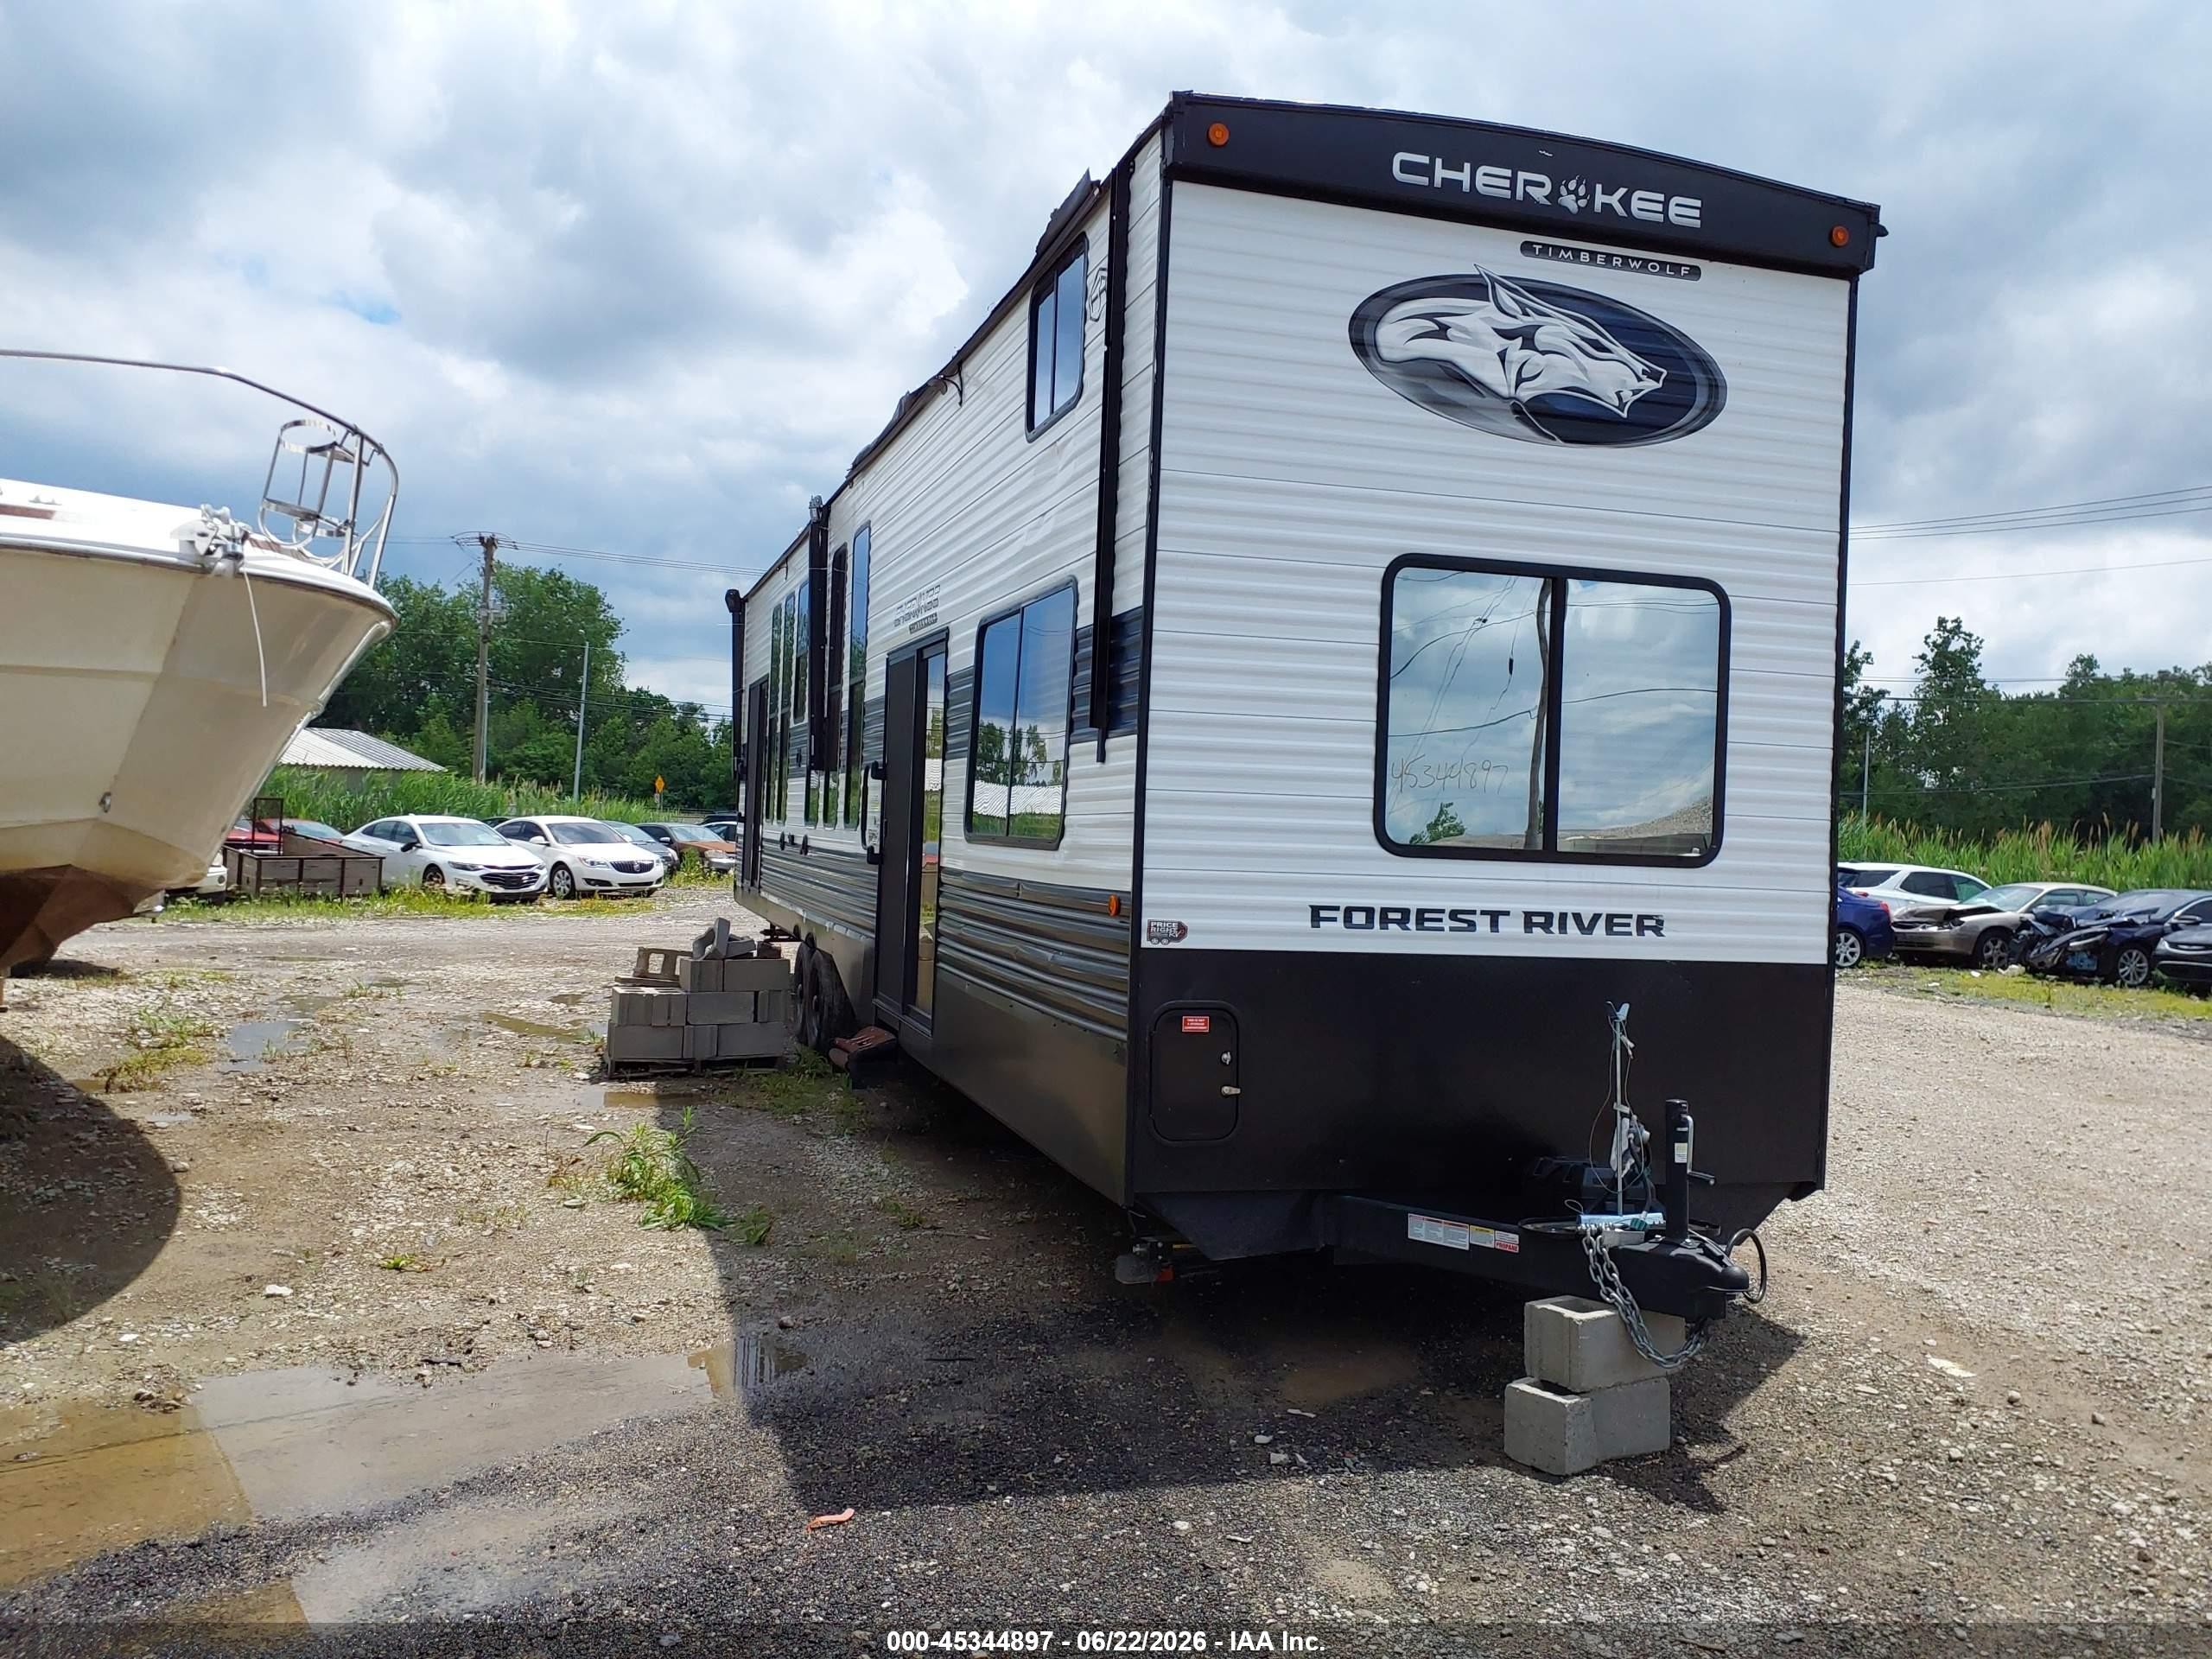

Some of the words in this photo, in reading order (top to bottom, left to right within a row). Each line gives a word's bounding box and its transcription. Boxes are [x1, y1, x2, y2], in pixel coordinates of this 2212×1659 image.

[1532, 244, 1691, 277] TIMBERWOLF
[1391, 753, 1509, 794] 45344897
[1308, 905, 1511, 933] FOREST
[1522, 911, 1666, 938] RIVER
